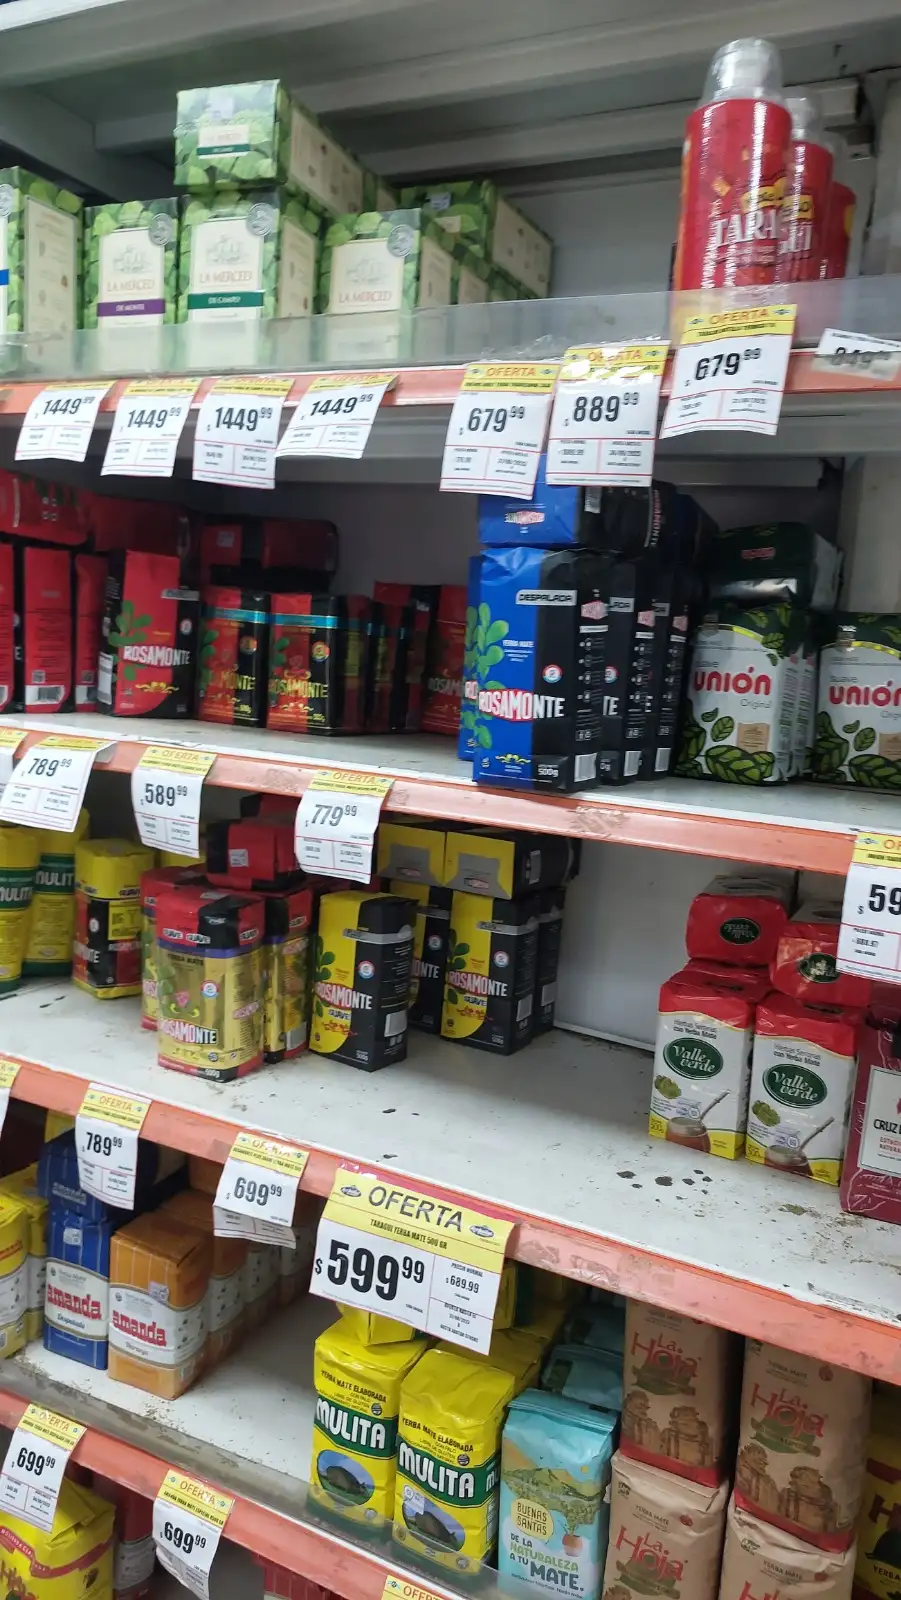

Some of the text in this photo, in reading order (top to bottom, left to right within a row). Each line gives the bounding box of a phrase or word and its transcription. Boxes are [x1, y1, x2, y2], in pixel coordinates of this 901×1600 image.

[709, 309, 768, 324] OFERTA
[486, 367, 536, 377] OFERTA
[695, 353, 740, 381] 679
[744, 348, 762, 360] 99
[42, 398, 82, 414] 1449
[310, 393, 374, 416] 1449 99
[574, 396, 620, 422] 889
[623, 393, 639, 405] 99
[127, 407, 182, 428] 1449 99
[216, 407, 258, 432] 1449
[260, 407, 273, 419] 99
[468, 408, 507, 432] 679
[510, 406, 525, 419] 99
[519, 593, 572, 603] DESPALADA
[122, 645, 192, 667] ROSAMONTE
[479, 690, 565, 719] ROSAMONTE
[162, 750, 200, 761] OFERTA
[28, 758, 72, 777] 789 99
[333, 772, 376, 784] OFERTA
[538, 768, 559, 778] 500g
[145, 783, 176, 806] 589
[176, 785, 187, 796] 99
[312, 804, 357, 826] 779 99
[857, 905, 864, 914] $
[449, 972, 508, 997] ROSAMONTE
[315, 982, 372, 1010] ROSAMONTE
[464, 996, 487, 1006] SUAVE
[328, 1009, 351, 1020] SUAVE
[701, 1031, 716, 1039] Mate
[672, 1045, 706, 1062] Valle
[786, 1054, 802, 1062] Yerba
[804, 1057, 821, 1067] Mate
[680, 1059, 716, 1073] verde
[772, 1071, 809, 1090] Valle
[99, 1096, 132, 1111] OFERTA
[780, 1085, 818, 1101] verde
[873, 1118, 898, 1134] CRUZ
[86, 1132, 122, 1156] 789 99
[234, 1177, 269, 1206] 699
[270, 1184, 282, 1196] 99
[368, 1186, 463, 1232] OFERTA
[370, 1219, 393, 1232] TARAGUI
[394, 1226, 410, 1238] YERBA
[411, 1232, 426, 1243] MATE
[427, 1237, 438, 1246] 500
[315, 1239, 424, 1301] $ 599 99
[450, 1275, 480, 1293] 689.99
[47, 1284, 101, 1320] amanda
[112, 1310, 167, 1346] amanda
[631, 1333, 698, 1378] Hoja
[336, 1379, 352, 1390] MATE
[353, 1385, 386, 1403] ELABORADA
[750, 1382, 824, 1438] Hoja
[317, 1397, 386, 1449] MULITA
[423, 1425, 436, 1439] MATE
[438, 1434, 474, 1452] ELABORADA
[17, 1447, 45, 1476] 699
[45, 1456, 56, 1468] 99
[399, 1441, 475, 1498] MULITA
[180, 1480, 215, 1504] OFERTA
[517, 1502, 547, 1522] BUENAS
[517, 1516, 547, 1535] SANTAS
[164, 1521, 206, 1554] 699 99
[523, 1538, 532, 1547] LA
[644, 1532, 662, 1550] La
[510, 1542, 578, 1572] NATURALEZA
[615, 1525, 684, 1582] Hoja
[518, 1555, 528, 1565] TU
[530, 1561, 584, 1591] MATE.
[873, 1565, 900, 1580] YERBA
[404, 1586, 440, 1600] OFER
